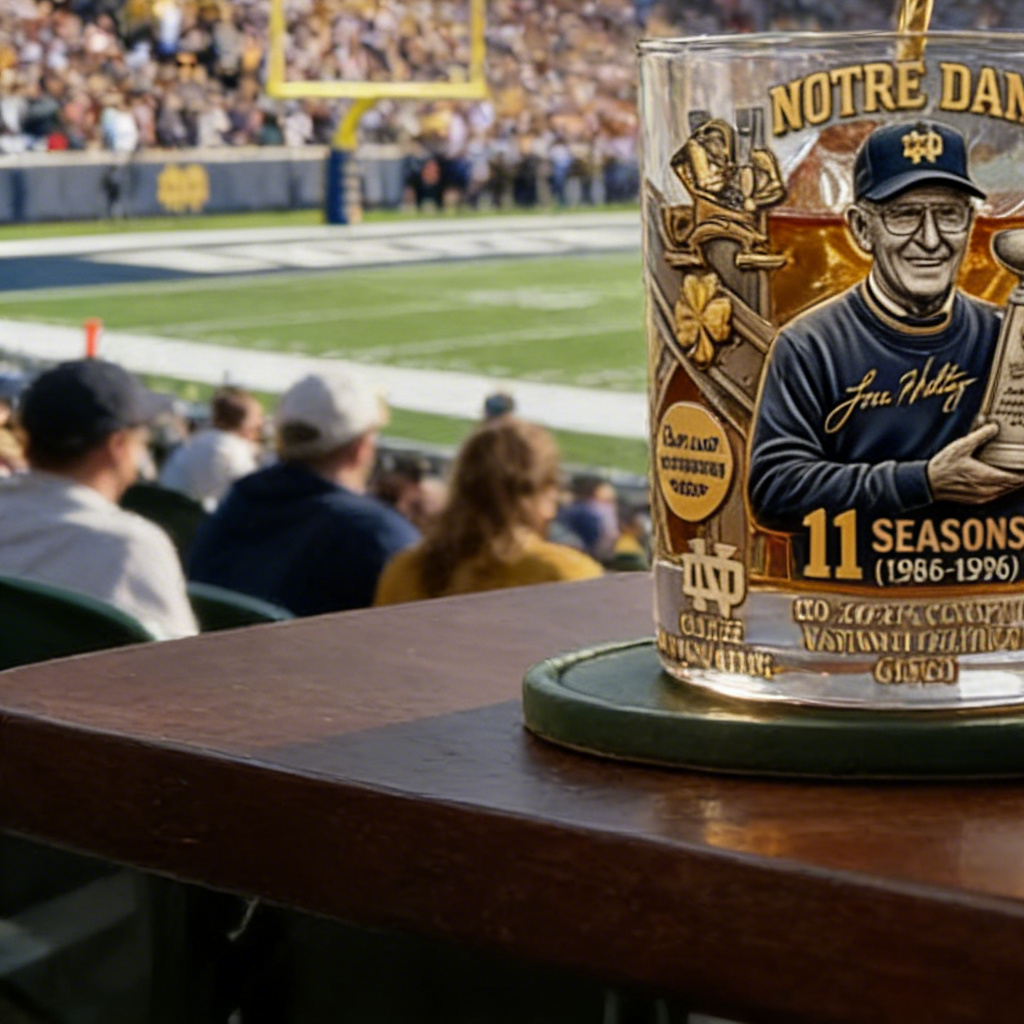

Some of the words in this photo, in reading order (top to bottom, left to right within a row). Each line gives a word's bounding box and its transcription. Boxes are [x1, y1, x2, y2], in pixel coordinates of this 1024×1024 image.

[769, 59, 926, 136] NOTRE
[802, 507, 863, 580] 11
[875, 555, 1020, 587] (1986-1996)
